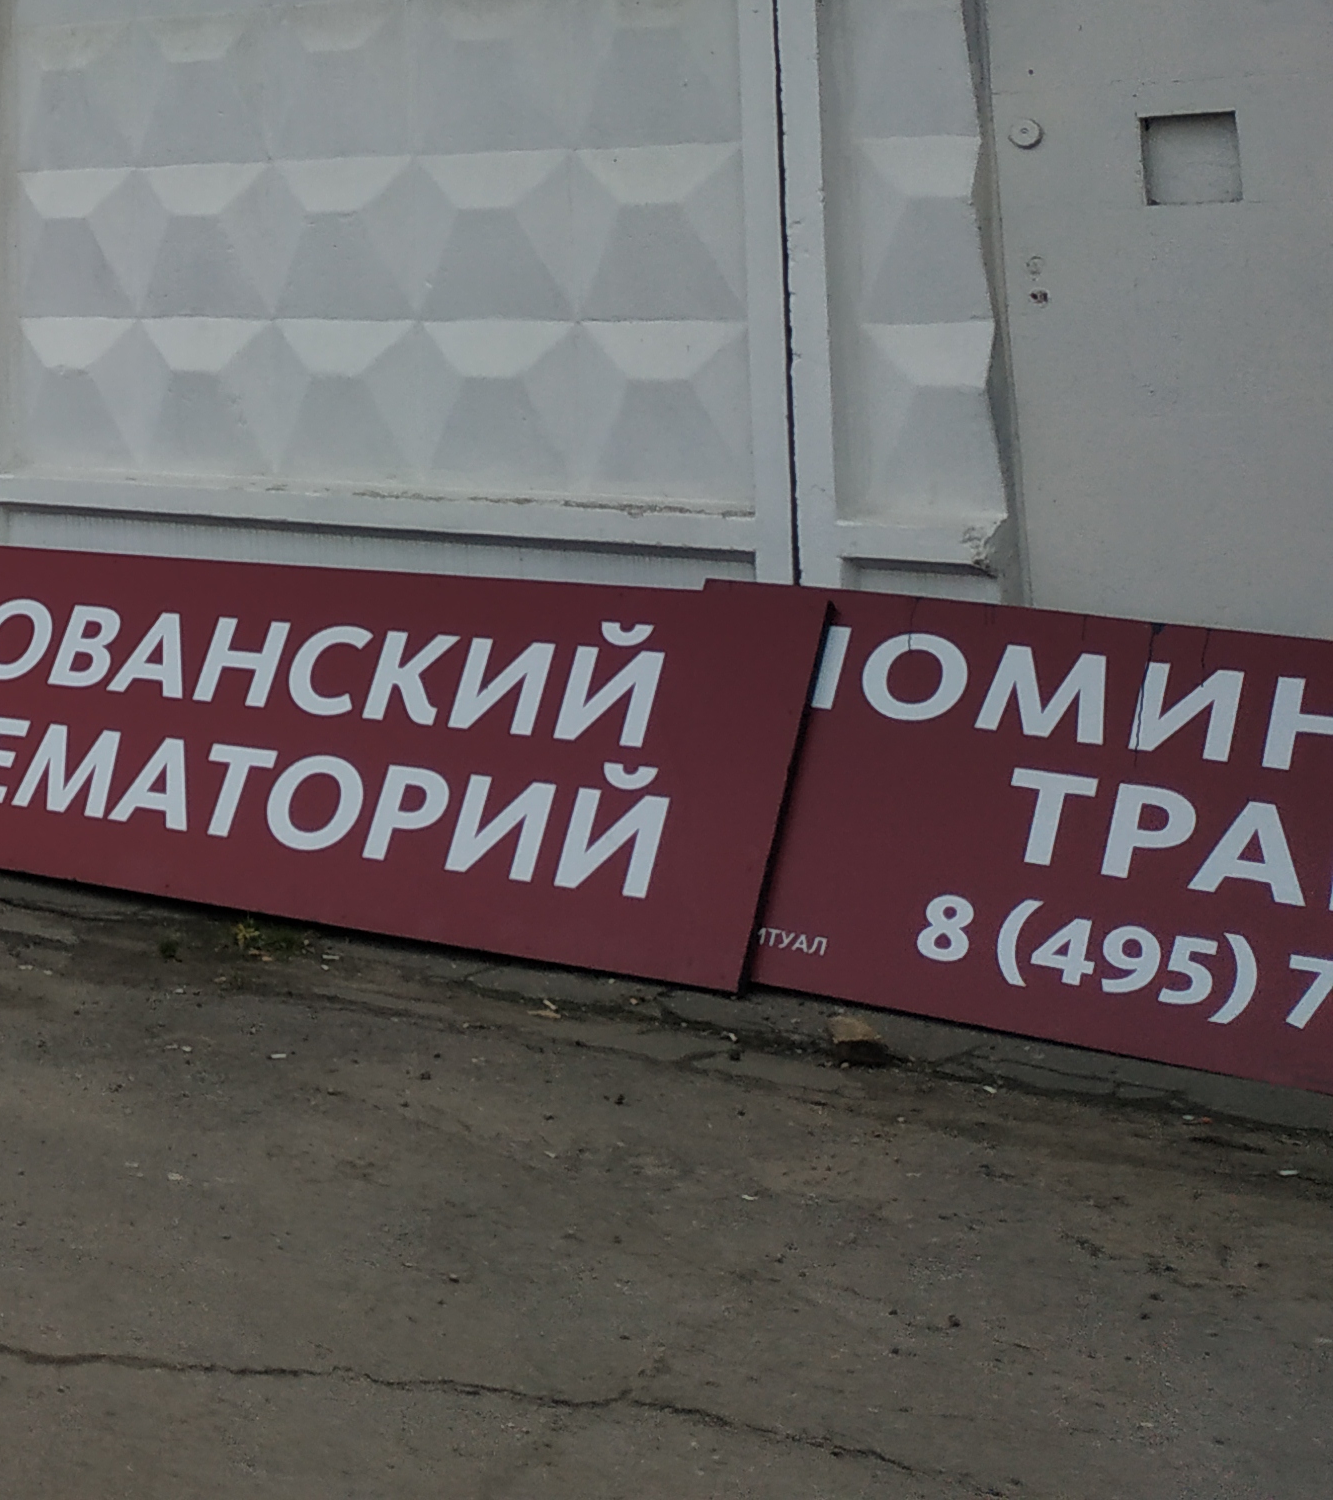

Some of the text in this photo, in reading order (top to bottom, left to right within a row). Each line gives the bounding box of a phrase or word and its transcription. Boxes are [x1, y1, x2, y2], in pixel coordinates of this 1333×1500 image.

[1011, 768, 1333, 911] ТРА
[917, 895, 974, 961] 8
[997, 900, 1257, 1024] (495)
